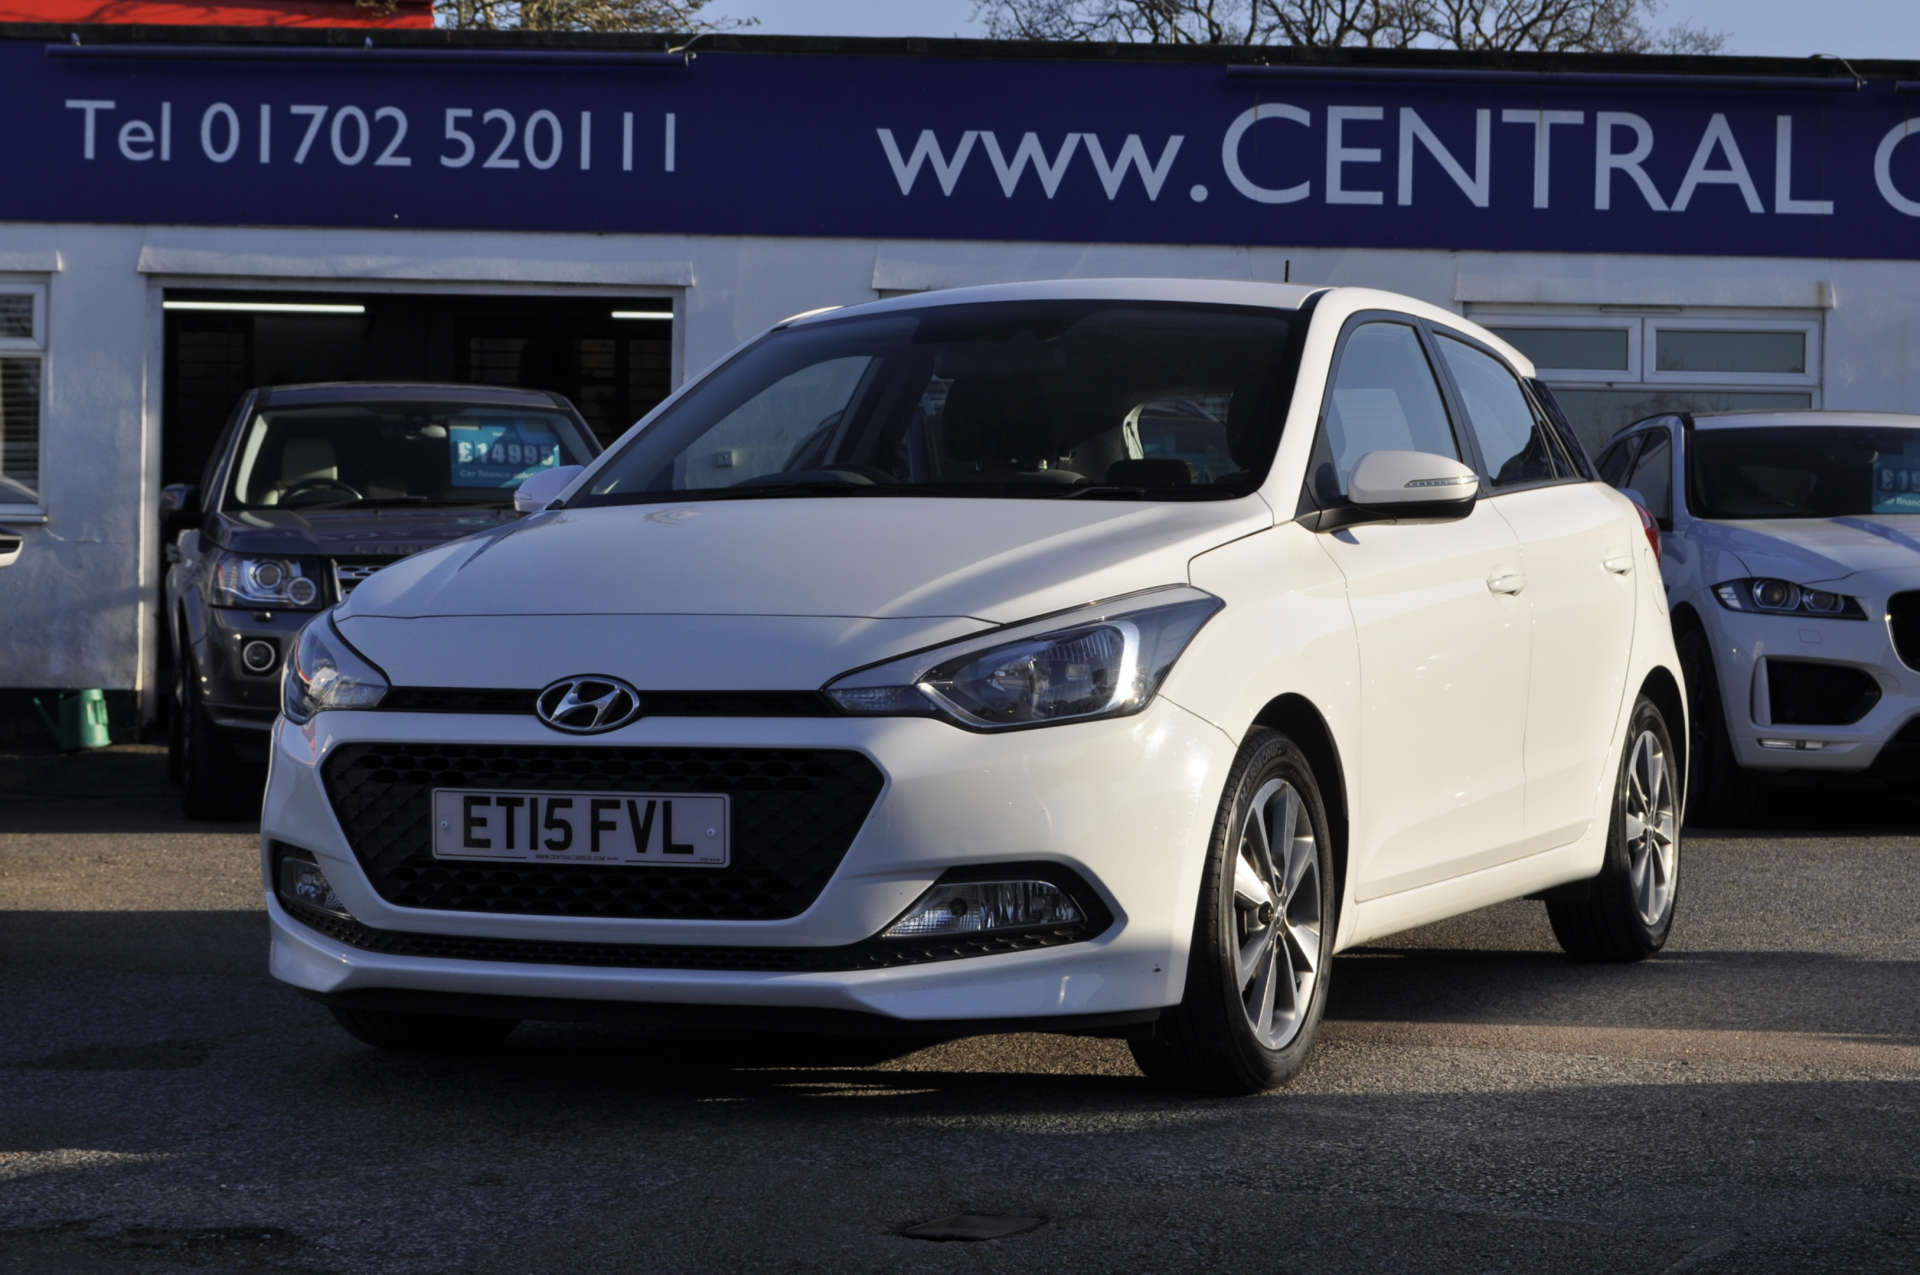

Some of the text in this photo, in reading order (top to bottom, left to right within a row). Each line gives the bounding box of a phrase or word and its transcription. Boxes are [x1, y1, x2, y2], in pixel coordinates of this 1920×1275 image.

[65, 99, 677, 172] Tel 01702 520111
[457, 441, 554, 465] £14995
[463, 794, 695, 856] ET15 FVL
